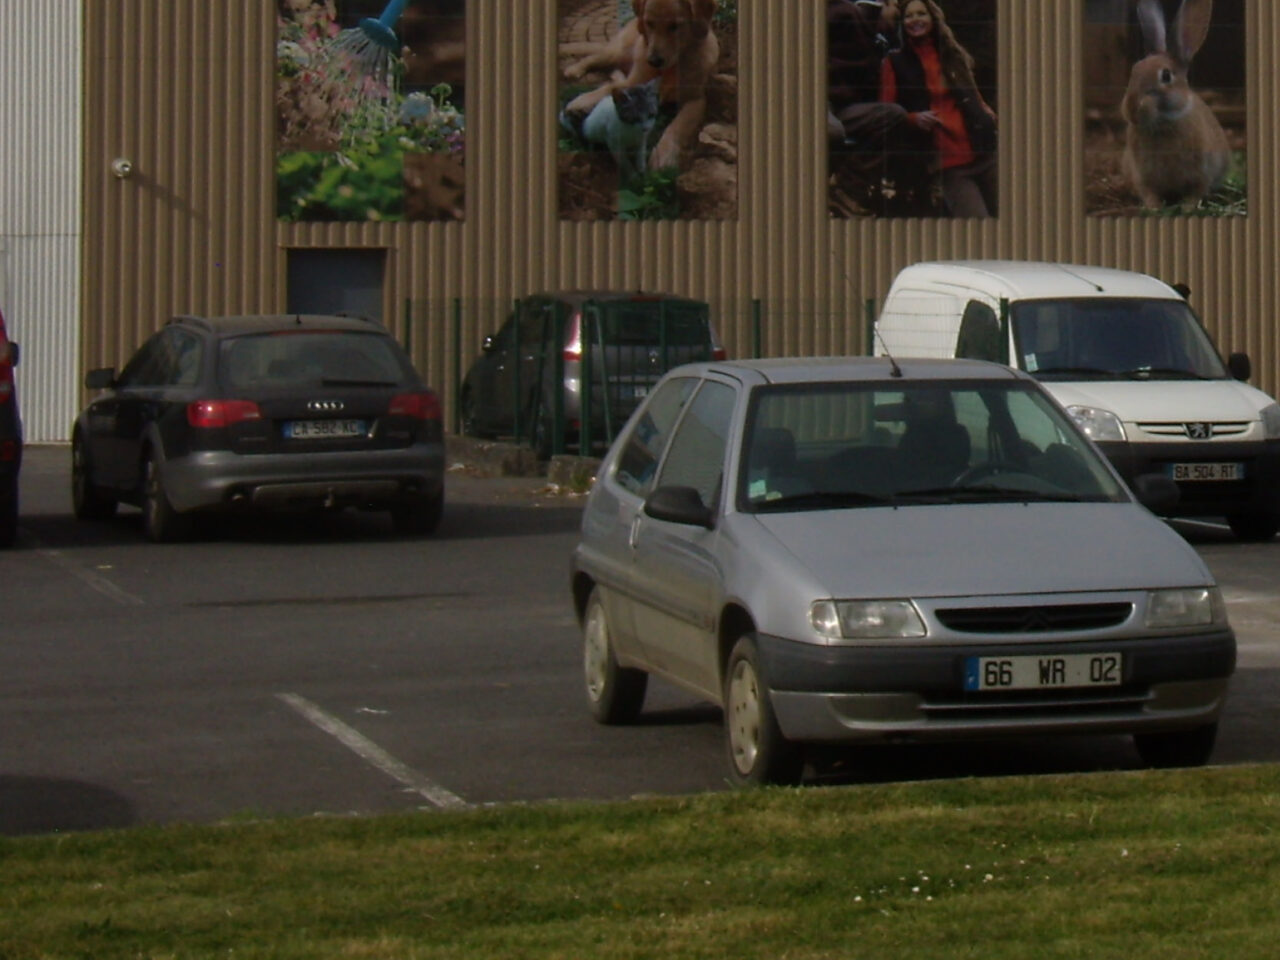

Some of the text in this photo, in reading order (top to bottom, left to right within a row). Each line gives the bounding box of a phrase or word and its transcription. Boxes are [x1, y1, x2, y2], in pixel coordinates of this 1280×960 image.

[985, 656, 1118, 687] 66 WR 02
